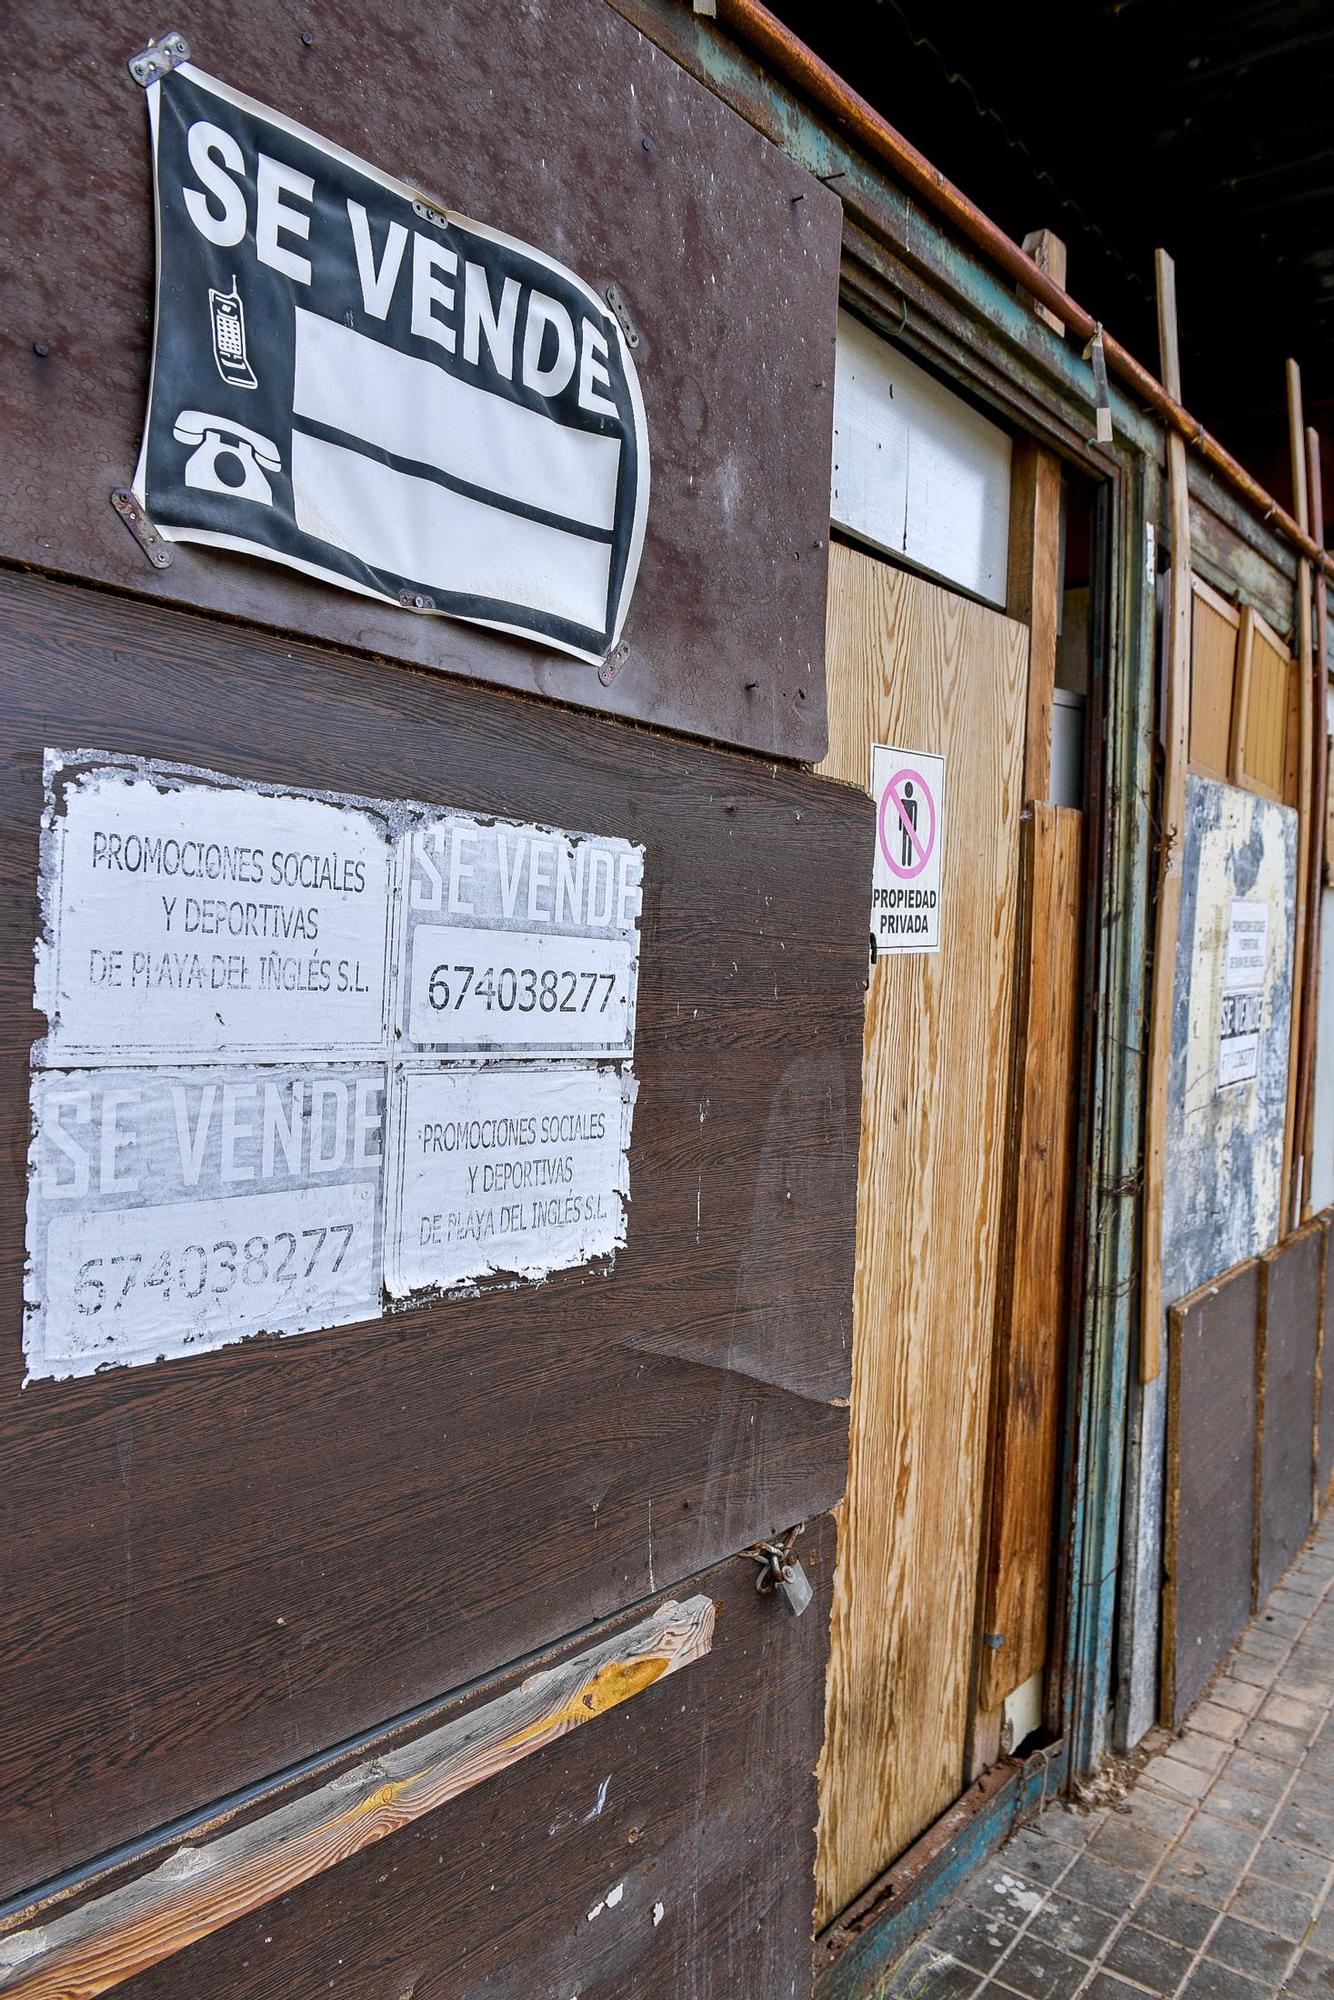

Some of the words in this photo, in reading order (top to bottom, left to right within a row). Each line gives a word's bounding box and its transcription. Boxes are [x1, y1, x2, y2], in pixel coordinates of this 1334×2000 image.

[182, 120, 316, 287] SE
[346, 199, 619, 420] VENDE
[92, 830, 265, 884] PROMOCIONES
[269, 850, 366, 894] SOCIALES
[410, 826, 479, 915] SE
[497, 834, 644, 929] VENDE
[161, 895, 178, 931] Y
[184, 897, 319, 940] DEPORTIVAS
[872, 888, 937, 909] PROPIEDAD
[880, 914, 929, 934] PRIVADA
[89, 949, 123, 987] DE
[428, 964, 616, 1013] 674038277
[41, 1088, 141, 1200] SE
[171, 1077, 385, 1187] VENDE
[423, 1117, 537, 1153] PROMOCIONES
[540, 1112, 606, 1144] SOCIALES
[468, 1165, 479, 1194] Y
[483, 1156, 573, 1193] DEPORTIVAS
[419, 1214, 442, 1246] DE
[499, 1203, 527, 1235] DEL
[531, 1188, 583, 1230] INGLÉS
[73, 1223, 355, 1316] 674038277
